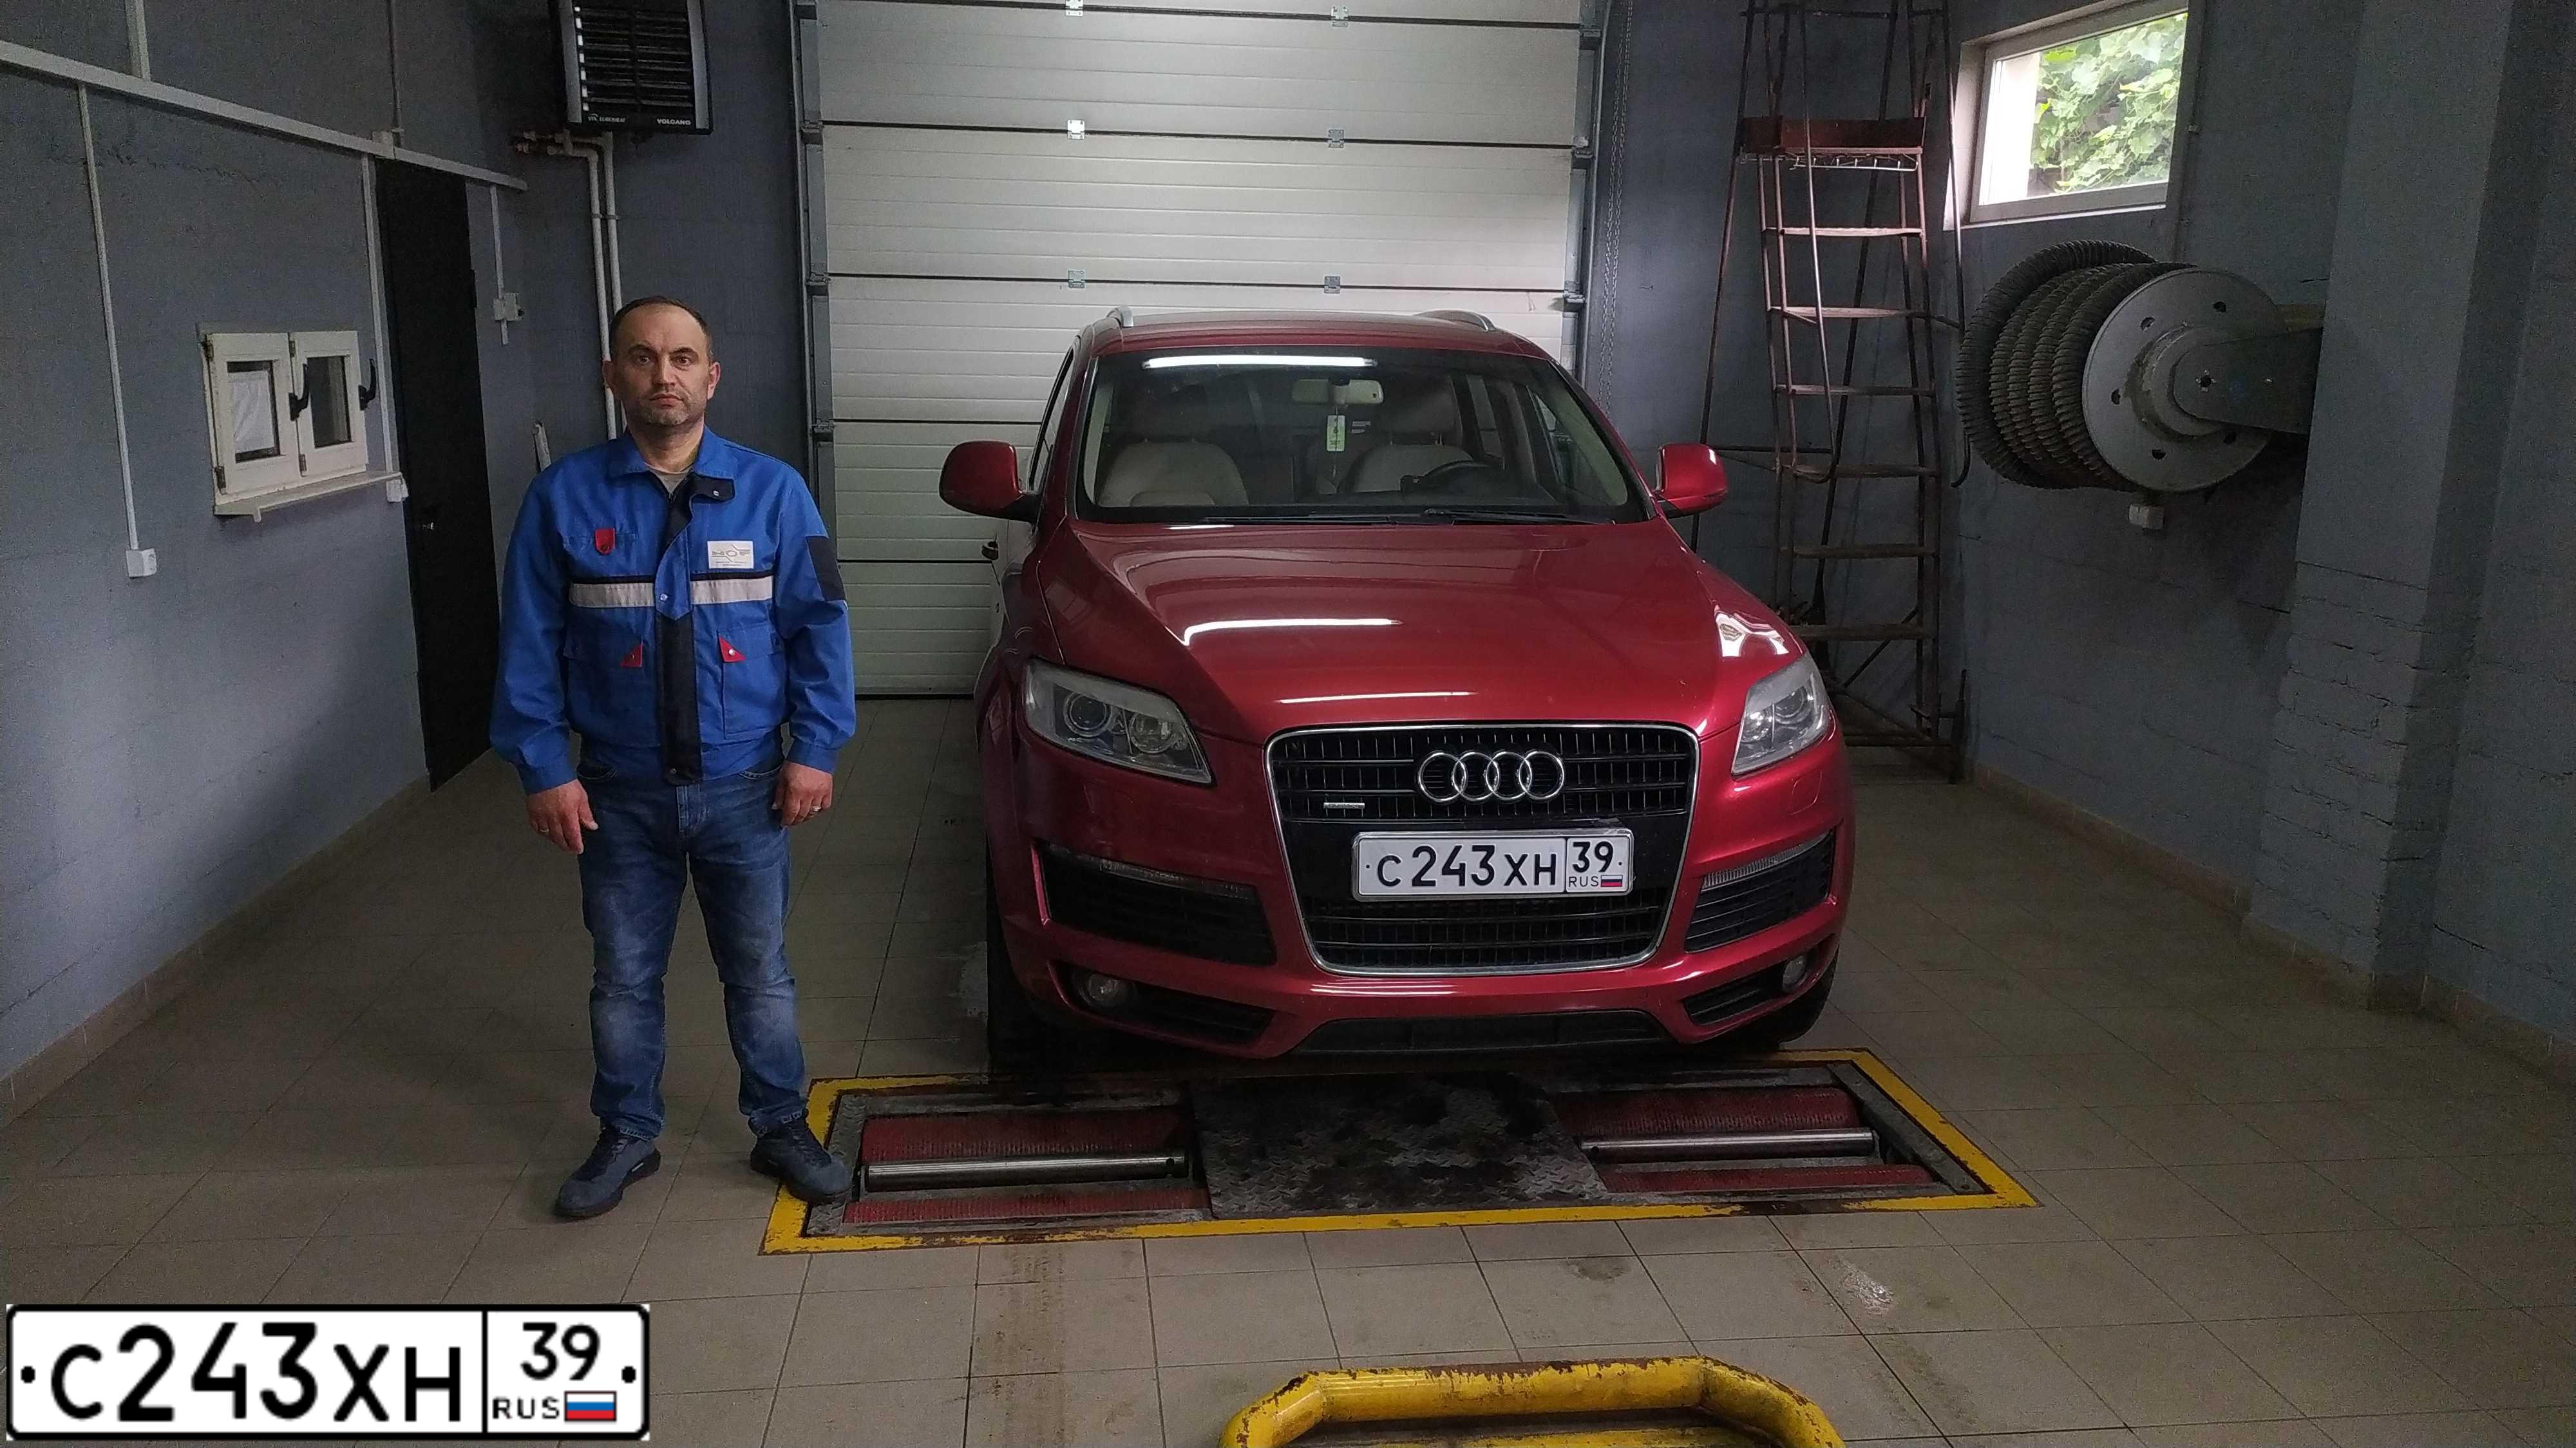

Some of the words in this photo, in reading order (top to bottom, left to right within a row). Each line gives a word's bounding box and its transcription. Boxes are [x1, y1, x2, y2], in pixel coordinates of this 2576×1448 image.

[1377, 844, 1557, 887] C243XH
[1572, 841, 1614, 873] 39
[1568, 875, 1599, 888] RUS
